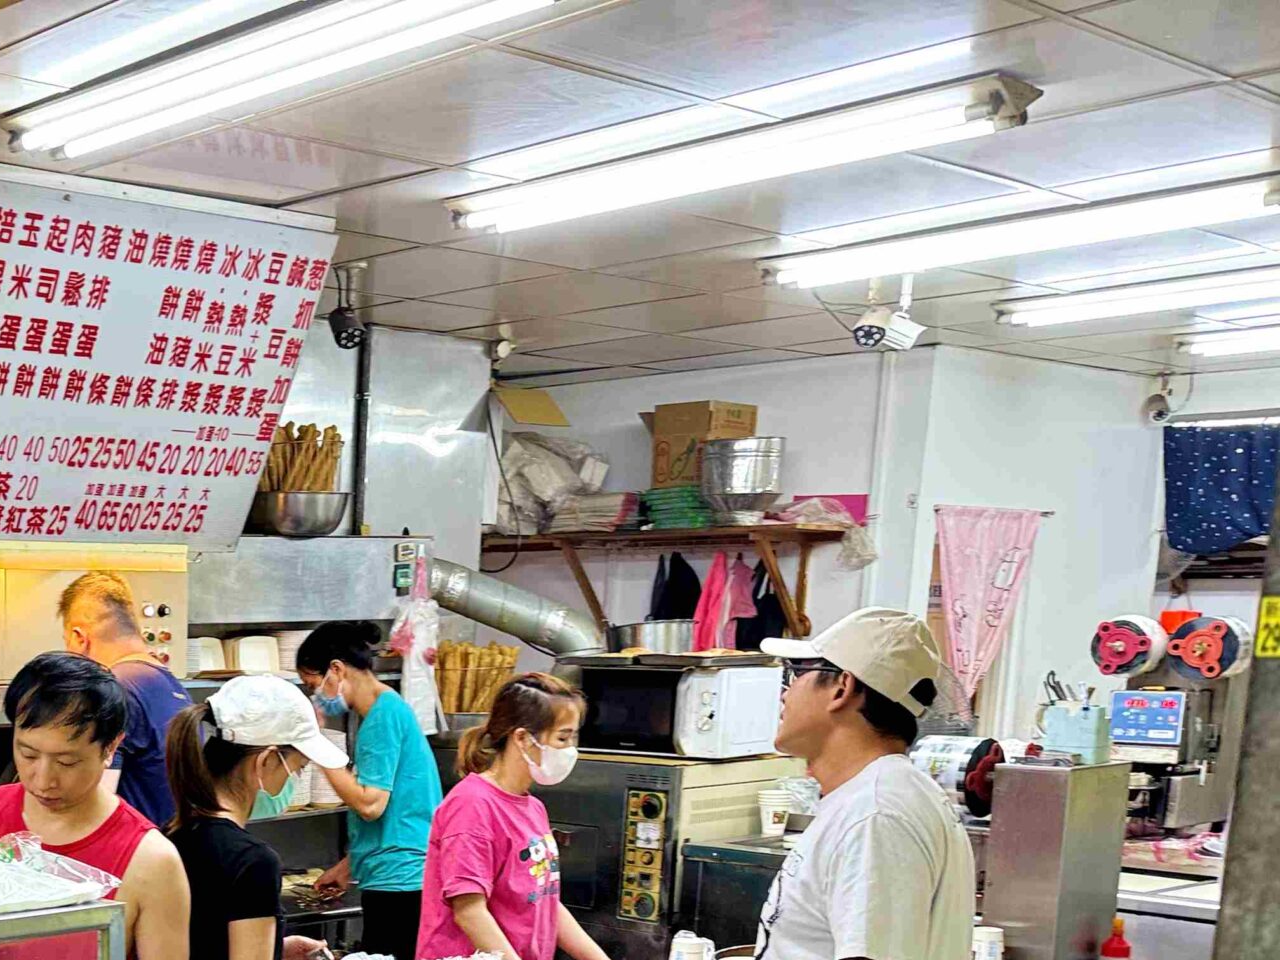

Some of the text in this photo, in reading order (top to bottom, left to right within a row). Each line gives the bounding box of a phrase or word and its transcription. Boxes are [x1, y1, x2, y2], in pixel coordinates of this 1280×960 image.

[11, 215, 70, 399] 起司蛋餅
[37, 221, 96, 401] 肉鬆蛋餅
[62, 224, 123, 402] 豬排蛋餅
[88, 228, 149, 405] 油條
[110, 232, 172, 408] 燒餅
[133, 236, 195, 409] 燒餅油條
[156, 240, 218, 411] 燒餅豬排
[244, 255, 310, 419] 鹹豆漿
[15, 475, 39, 501] 20
[23, 436, 44, 462] 40
[48, 437, 70, 463] 50
[67, 436, 93, 468] 25
[90, 437, 116, 469] 25
[112, 438, 136, 470] 50
[136, 441, 160, 472] 45
[157, 443, 181, 475] 20
[181, 446, 204, 476] 20
[204, 448, 227, 477] 20
[224, 447, 246, 477] 40
[245, 451, 265, 475] 55
[46, 505, 70, 535] 25
[74, 500, 208, 533] 40 65 60 25 25 25
